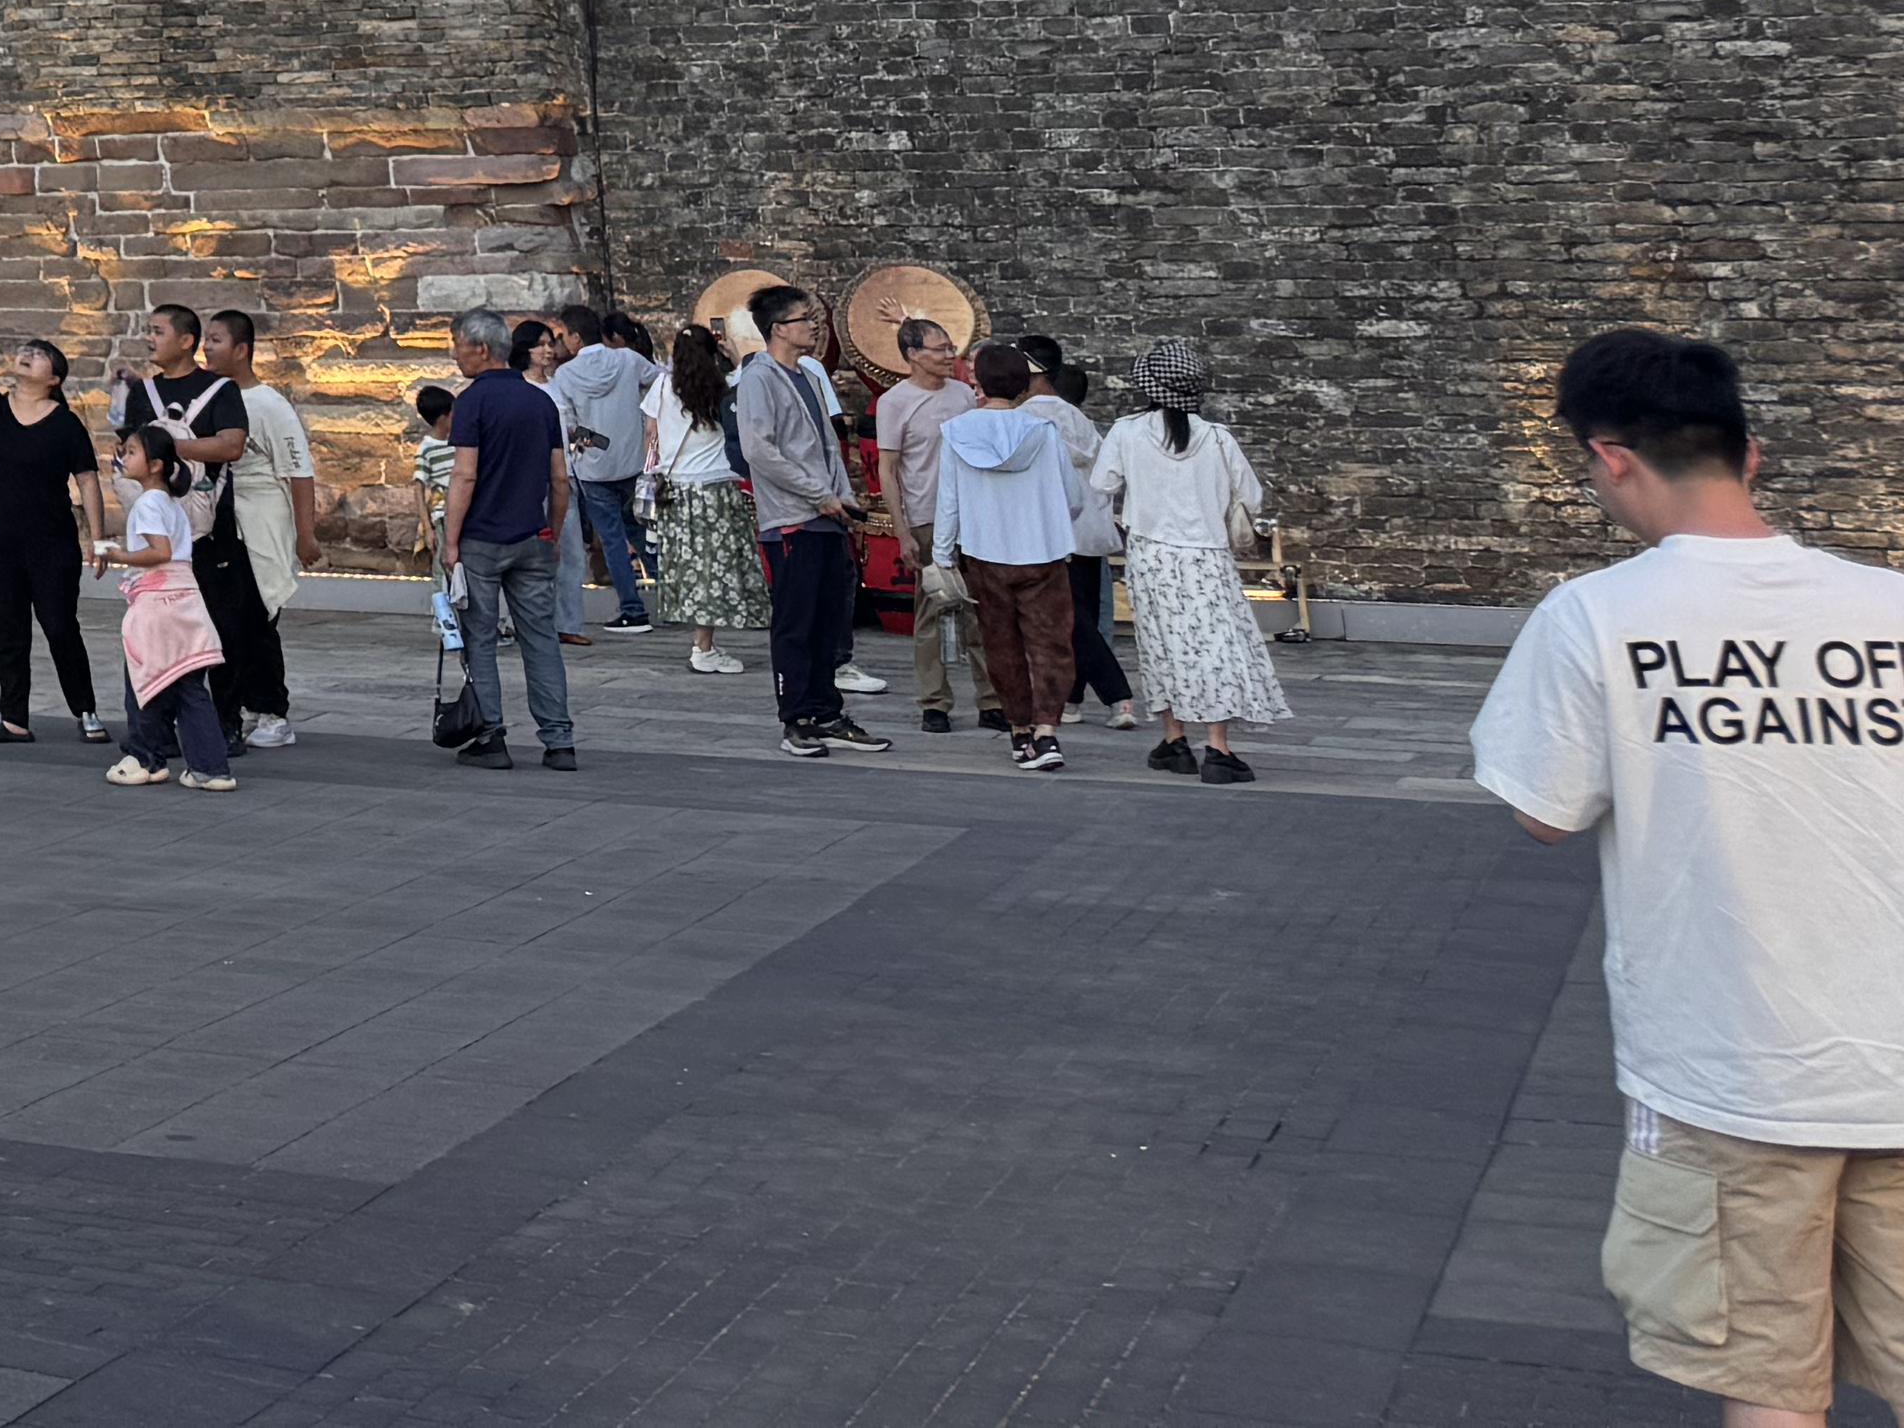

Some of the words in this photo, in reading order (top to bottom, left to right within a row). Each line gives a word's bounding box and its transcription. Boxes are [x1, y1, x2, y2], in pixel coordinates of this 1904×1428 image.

[1626, 640, 1787, 689] PLAY
[1816, 640, 1904, 688] OF
[1654, 696, 1904, 746] AGAINS
